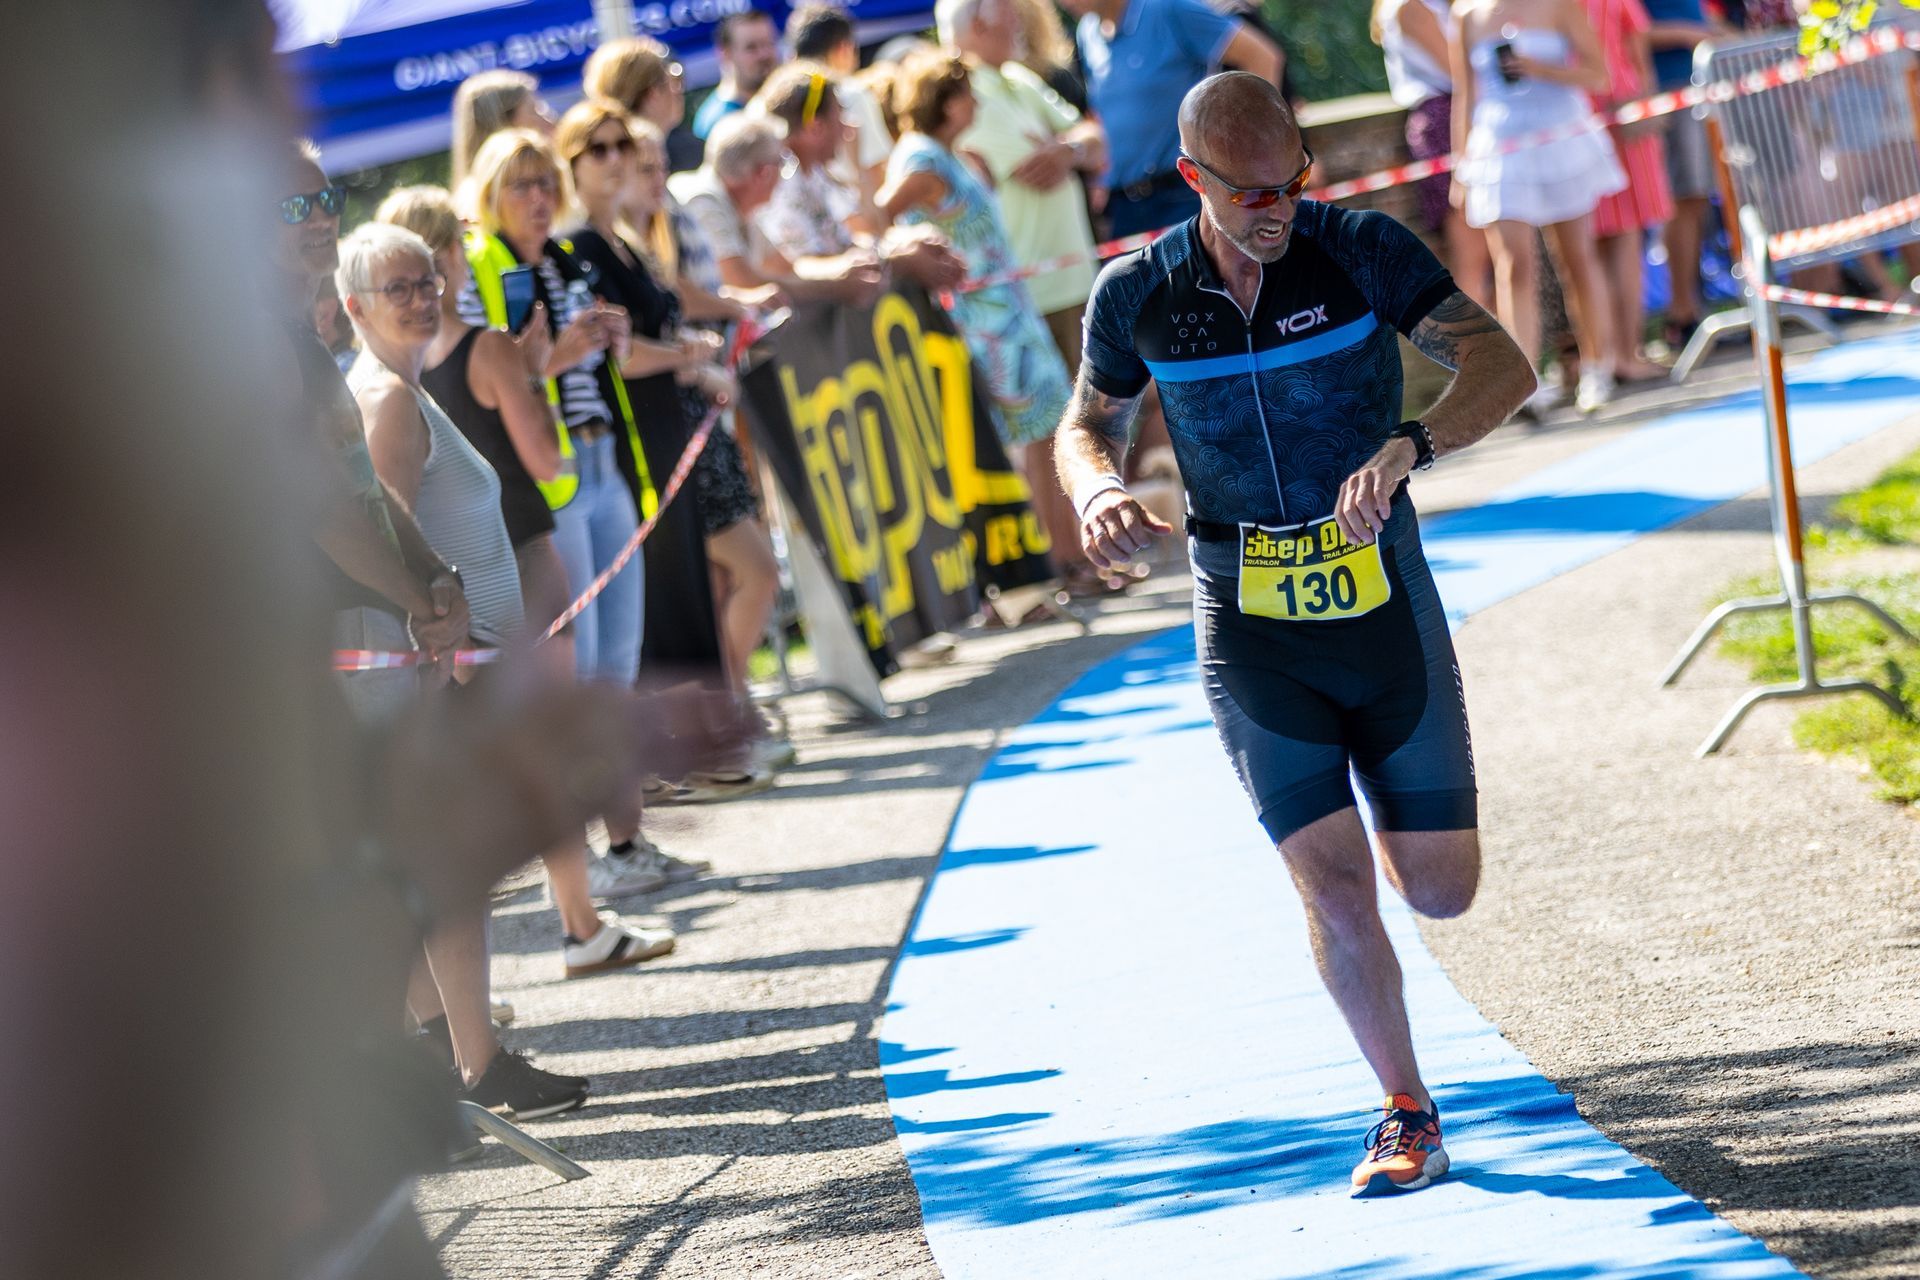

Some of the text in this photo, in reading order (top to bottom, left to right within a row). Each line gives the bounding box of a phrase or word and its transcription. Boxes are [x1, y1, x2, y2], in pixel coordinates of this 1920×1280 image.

[1171, 311, 1215, 324] VOX
[1276, 304, 1329, 336] VOX
[1245, 530, 1314, 565] Step
[1322, 550, 1342, 561] TRAIL
[1342, 544, 1357, 555] AND
[1276, 565, 1358, 617] 130
